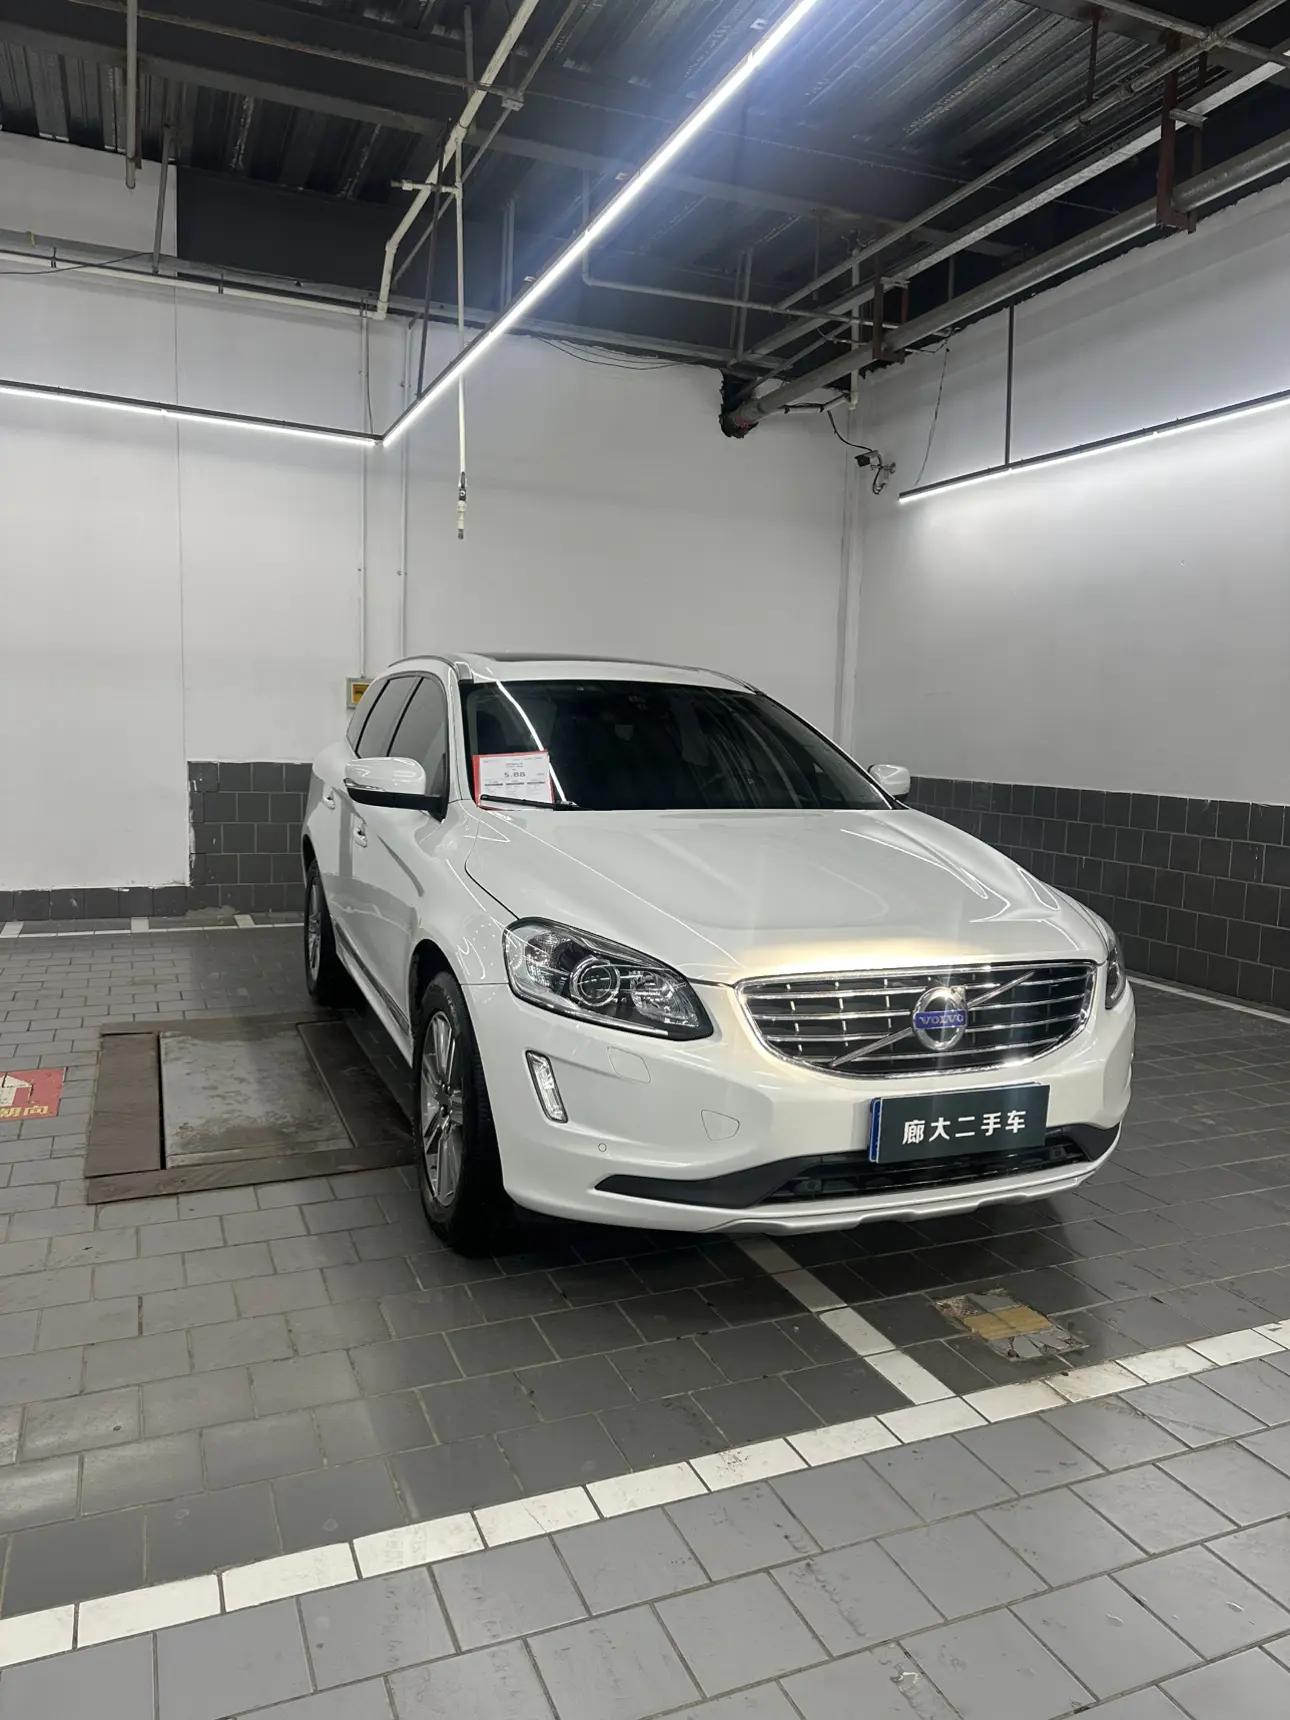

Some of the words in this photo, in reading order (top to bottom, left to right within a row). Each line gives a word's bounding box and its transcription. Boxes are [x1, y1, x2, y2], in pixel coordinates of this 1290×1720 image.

[919, 1013, 964, 1025] VOLVO
[902, 1110, 1026, 1145] 廊大二手车
